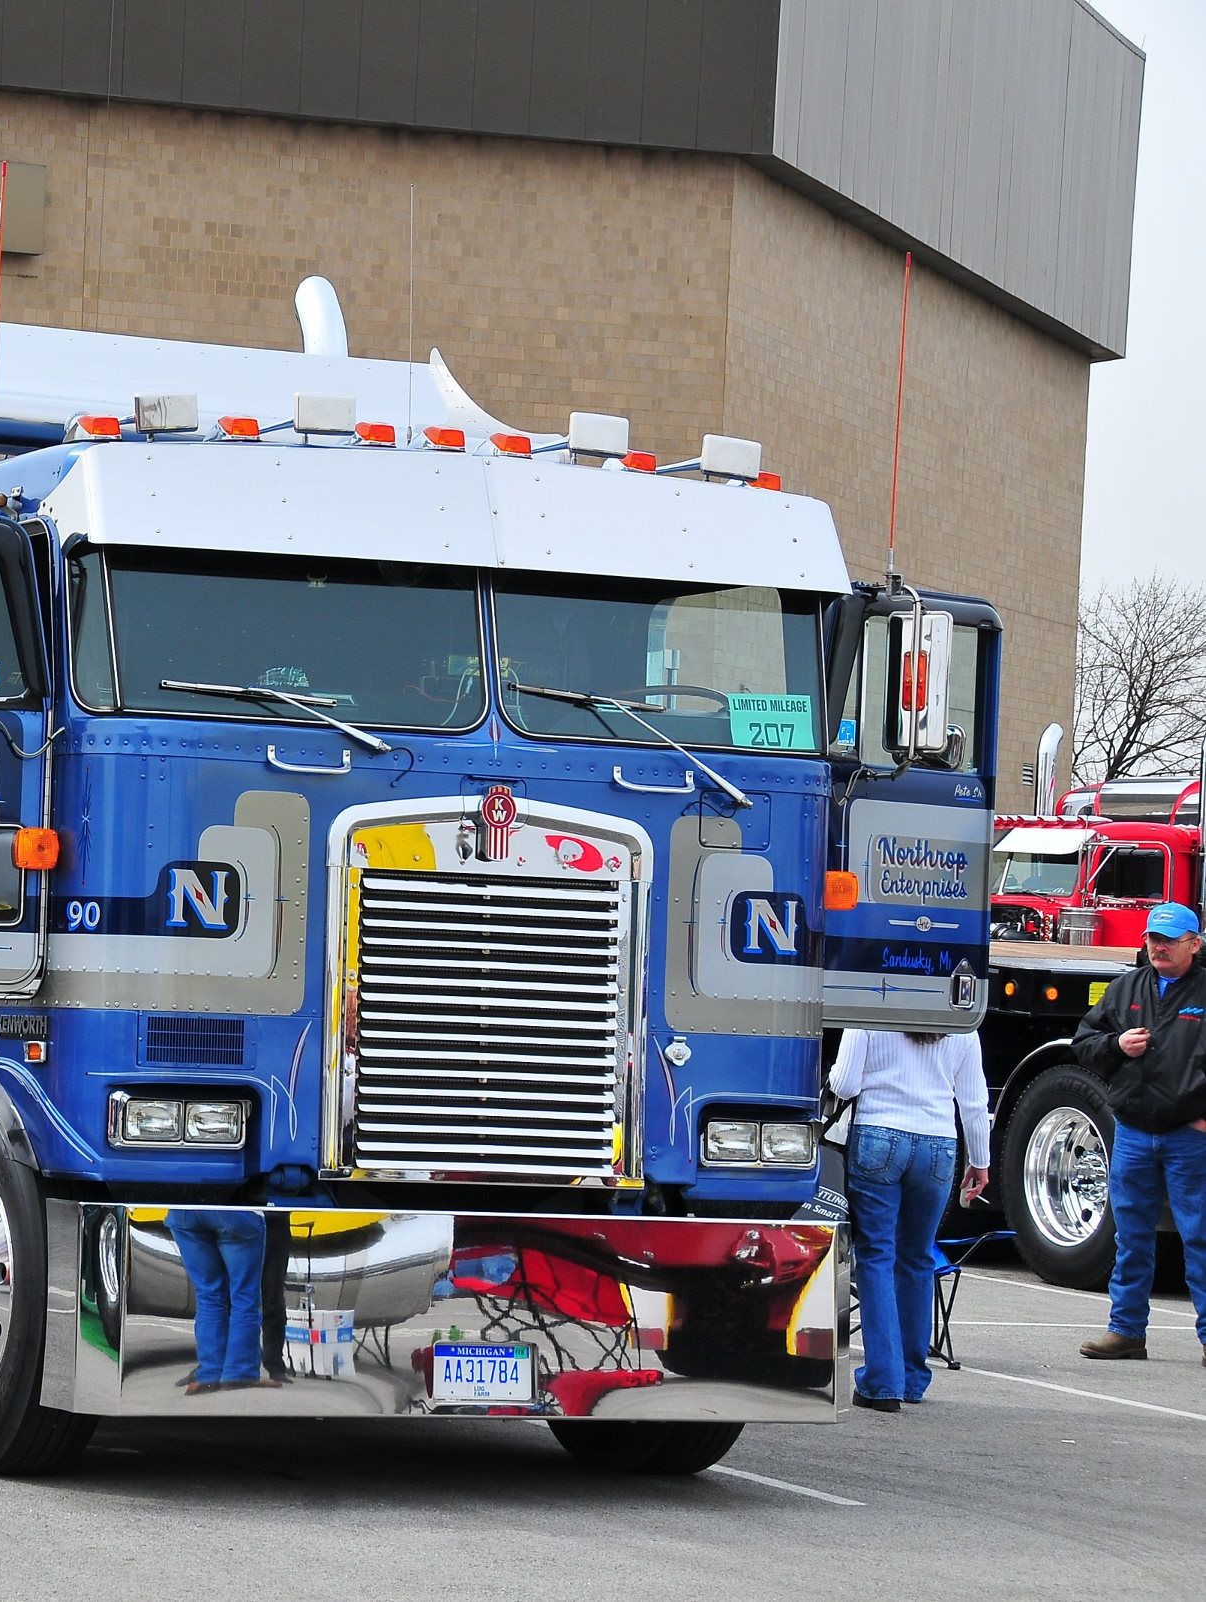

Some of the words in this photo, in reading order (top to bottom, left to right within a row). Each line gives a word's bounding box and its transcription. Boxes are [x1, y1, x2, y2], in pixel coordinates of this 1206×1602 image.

[732, 699, 768, 711] LIMITED
[770, 700, 808, 712] MILEAGE
[749, 722, 795, 747] 207
[877, 836, 969, 880] Northrop
[166, 868, 229, 929] N
[880, 868, 968, 905] Enterprises
[66, 900, 101, 931] 90
[743, 897, 799, 956] N
[813, 1204, 840, 1220] Smart
[457, 1347, 506, 1356] MICHIGAN
[444, 1360, 519, 1384] AA31784
